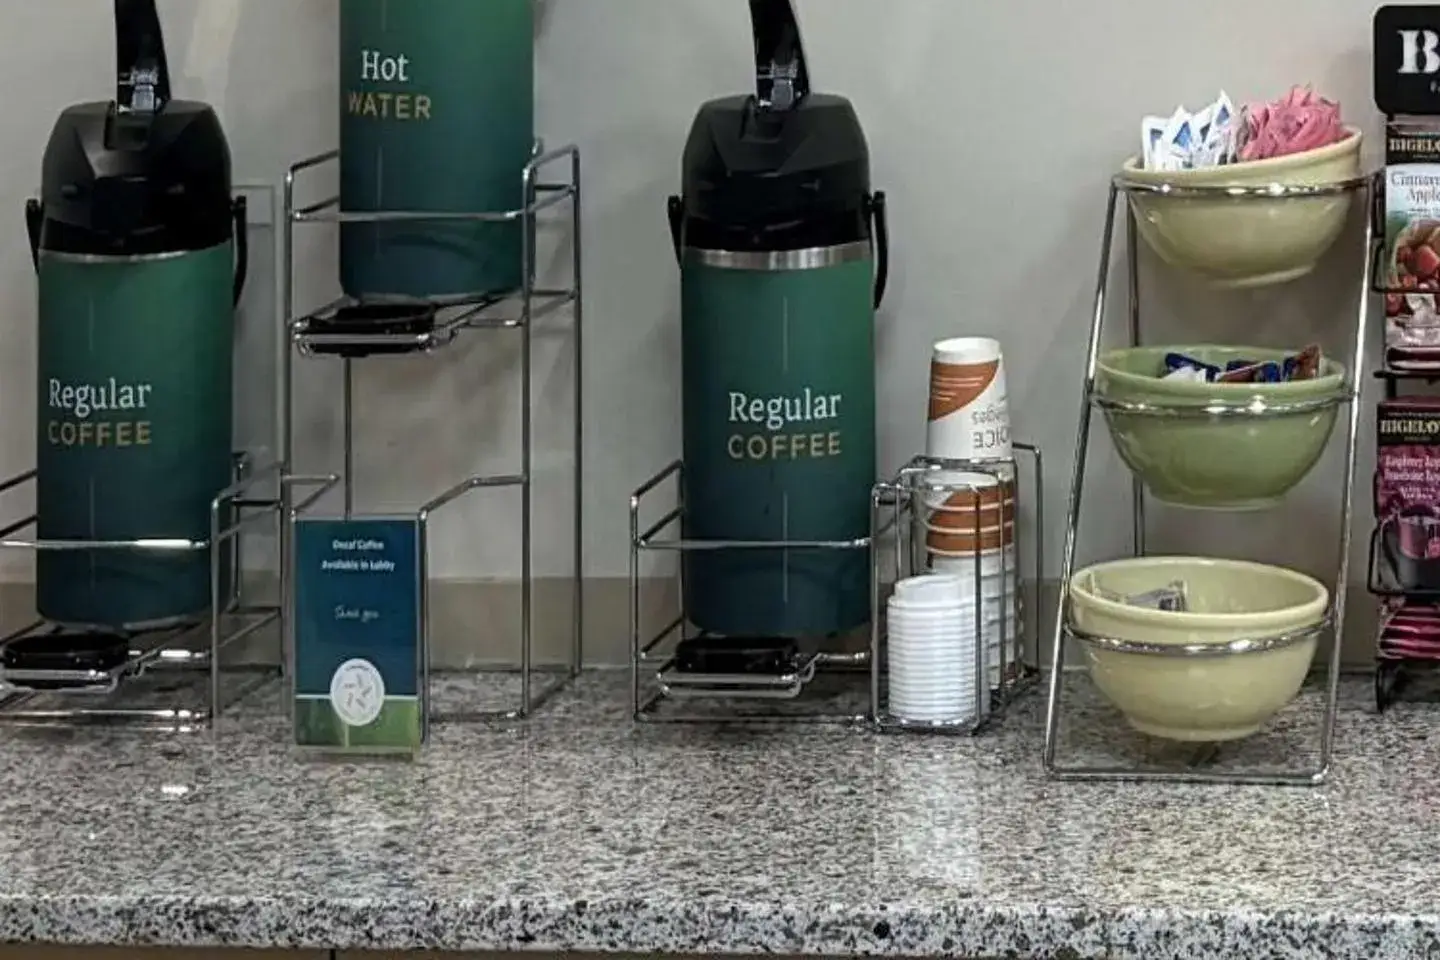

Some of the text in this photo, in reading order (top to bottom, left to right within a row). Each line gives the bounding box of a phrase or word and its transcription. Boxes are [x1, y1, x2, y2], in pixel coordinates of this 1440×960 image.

[361, 49, 410, 82] Hot
[347, 90, 432, 120] WATER
[48, 376, 153, 419] Regular
[728, 386, 842, 431] Regular
[47, 420, 153, 449] COFFEE
[727, 430, 843, 460] COFFEE
